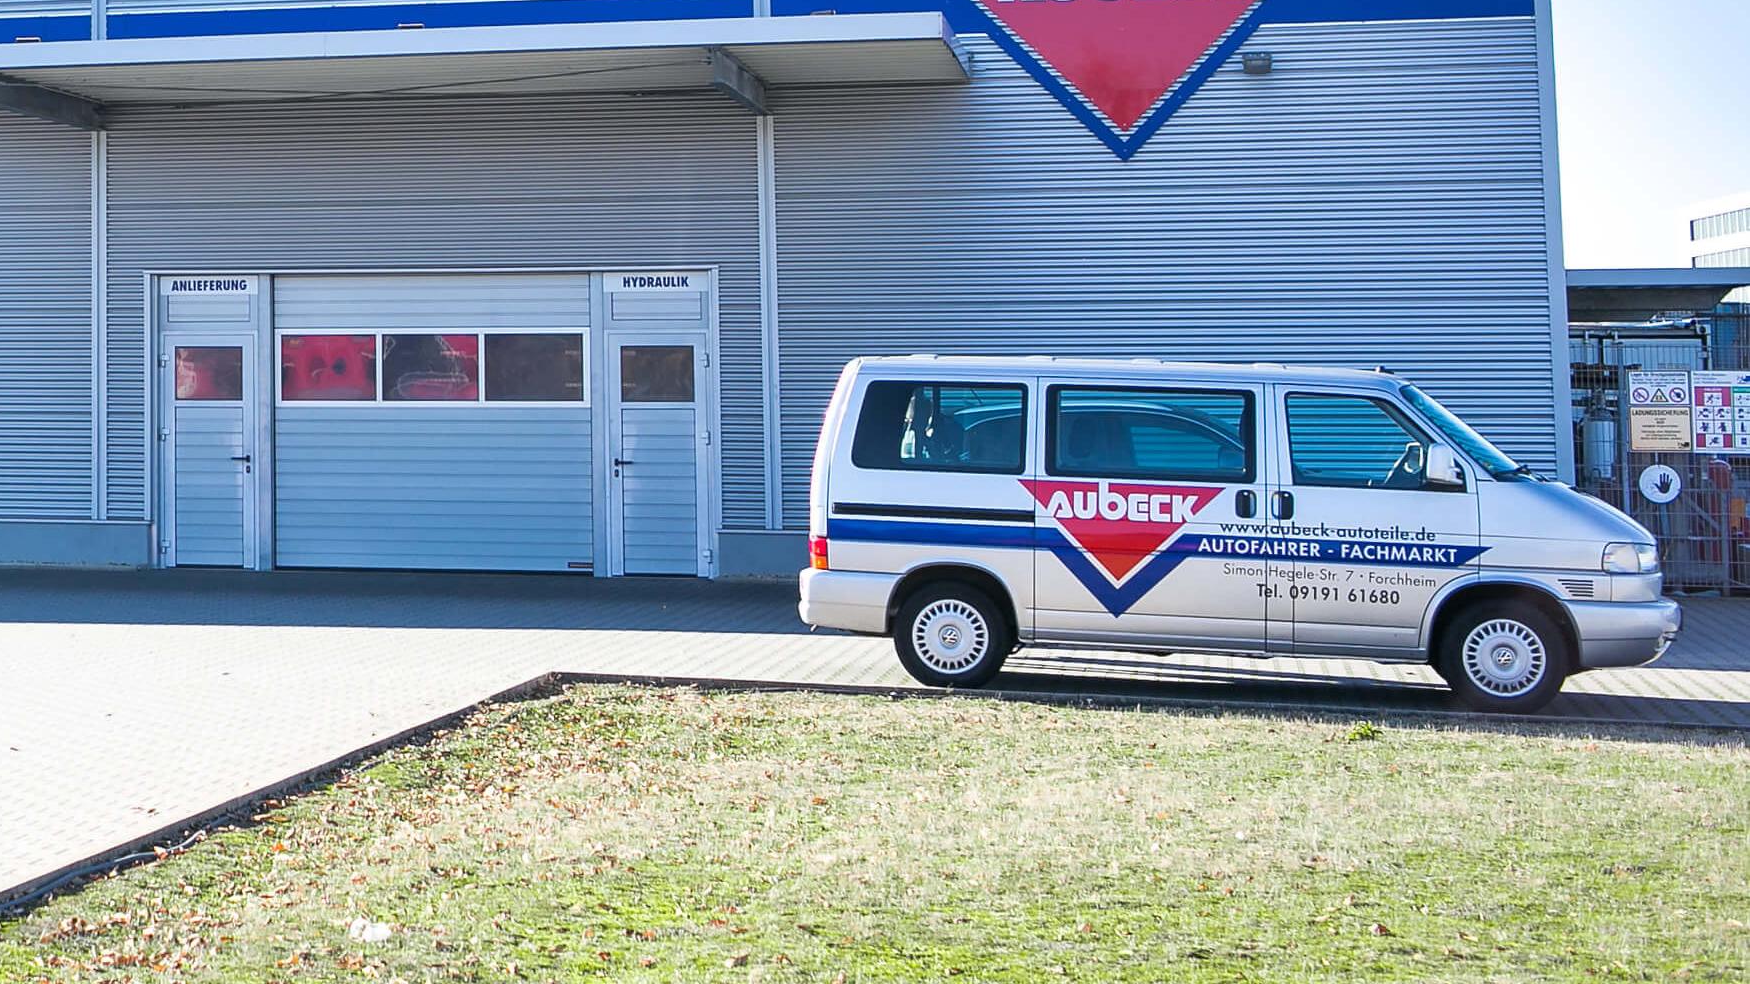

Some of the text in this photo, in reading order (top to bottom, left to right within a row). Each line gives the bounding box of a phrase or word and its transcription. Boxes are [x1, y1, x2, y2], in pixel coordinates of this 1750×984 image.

[171, 279, 248, 292] ANLIEFERUNG
[622, 276, 690, 289] HYDRAULIK
[1220, 521, 1437, 542] www.aubeck-autoteile.de
[1198, 536, 1321, 558] AUTOFAHRER
[1341, 543, 1458, 564] FACHMARKT
[1345, 569, 1355, 583] 7
[1369, 571, 1437, 588] Forchheim
[1256, 583, 1401, 605] Tel. 09191 61680
